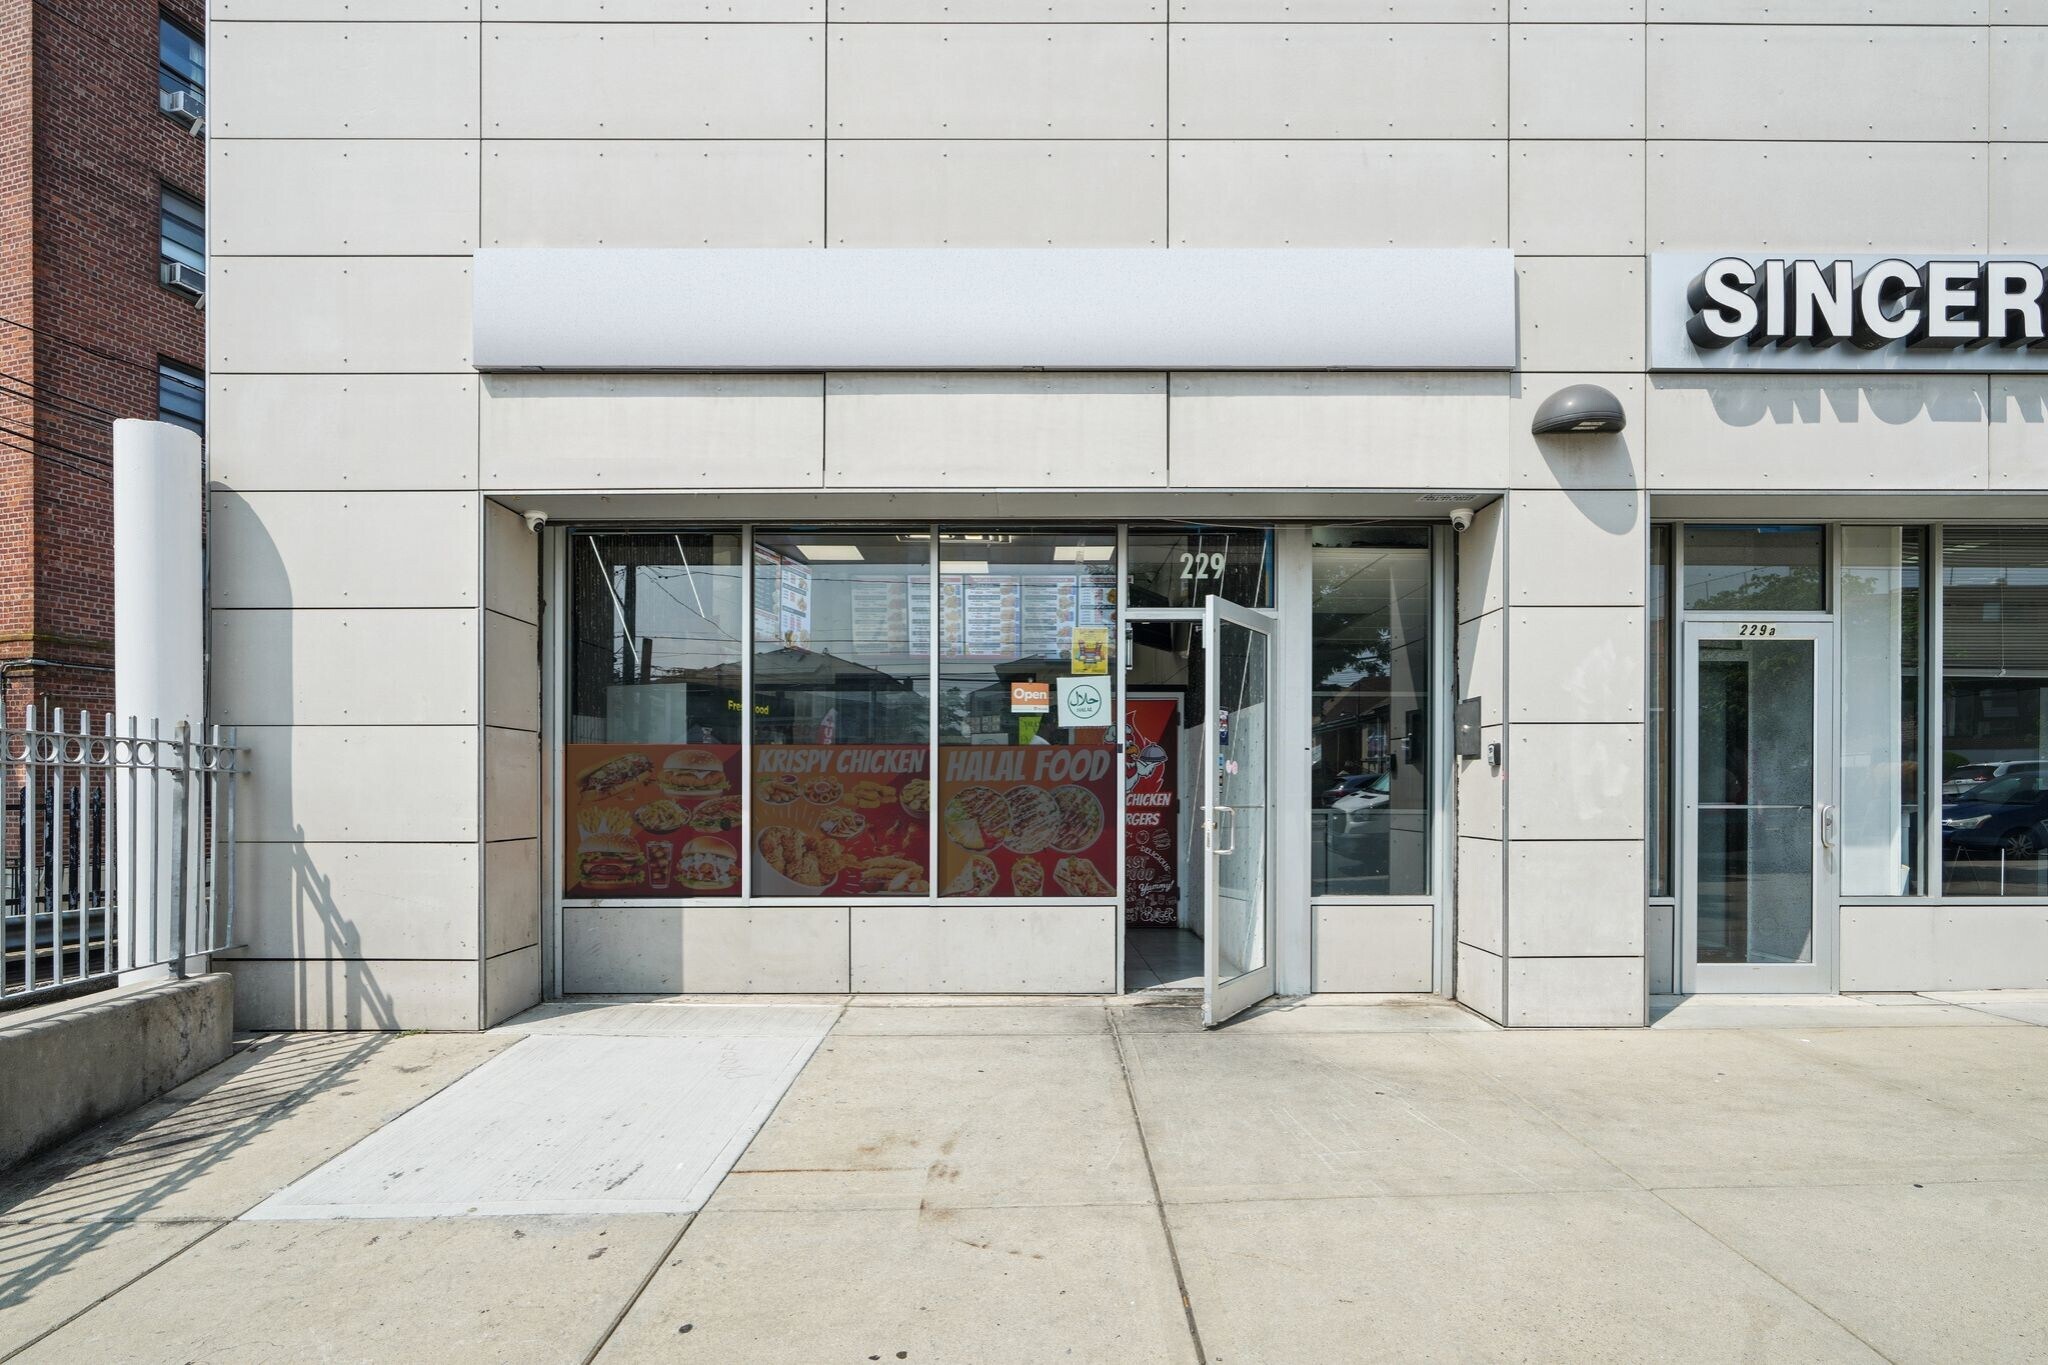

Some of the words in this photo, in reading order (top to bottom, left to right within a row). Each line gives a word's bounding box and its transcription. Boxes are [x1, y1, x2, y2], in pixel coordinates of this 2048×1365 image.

[1702, 257, 2048, 340] SINCER
[1180, 552, 1226, 579] 229
[1739, 624, 1776, 636] 229a
[1014, 688, 1047, 702] Open
[1069, 691, 1099, 706] حلال
[727, 700, 744, 712] Fre
[754, 705, 769, 715] ood
[756, 749, 833, 773] KRISPY
[836, 749, 926, 773] CHICKEN
[945, 750, 1026, 782] HALAL
[1033, 750, 1111, 782] FOOD
[1126, 793, 1171, 806] CHICKEN
[1126, 813, 1160, 826] RGERS
